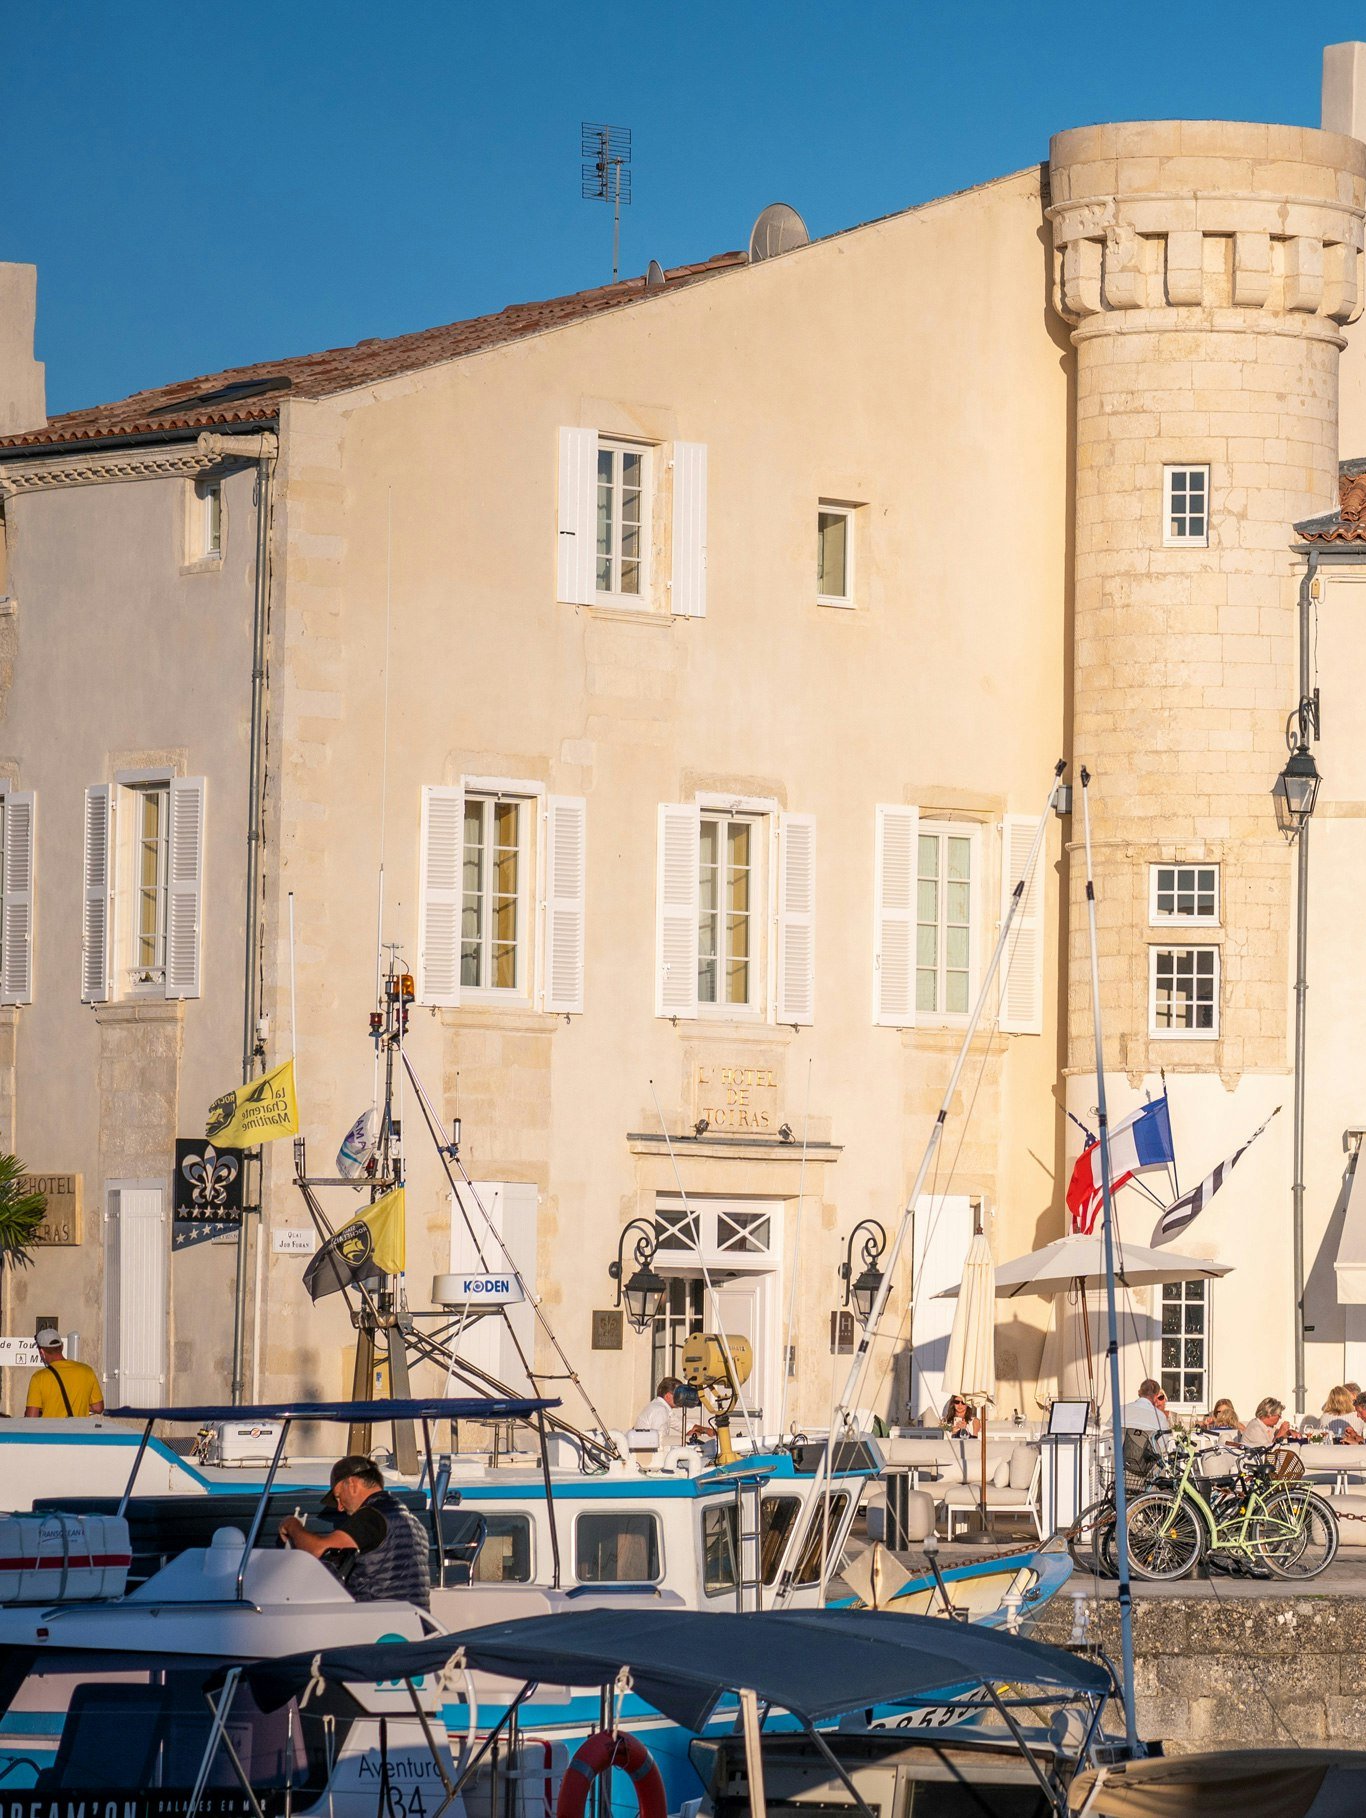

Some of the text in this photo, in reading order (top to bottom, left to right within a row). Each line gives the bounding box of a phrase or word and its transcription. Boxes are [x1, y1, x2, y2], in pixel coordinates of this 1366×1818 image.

[727, 1088, 750, 1107] DE
[703, 1108, 769, 1128] TOIRAS
[463, 1280, 509, 1293] KODEN
[0, 1801, 138, 1818] REAM'ON
